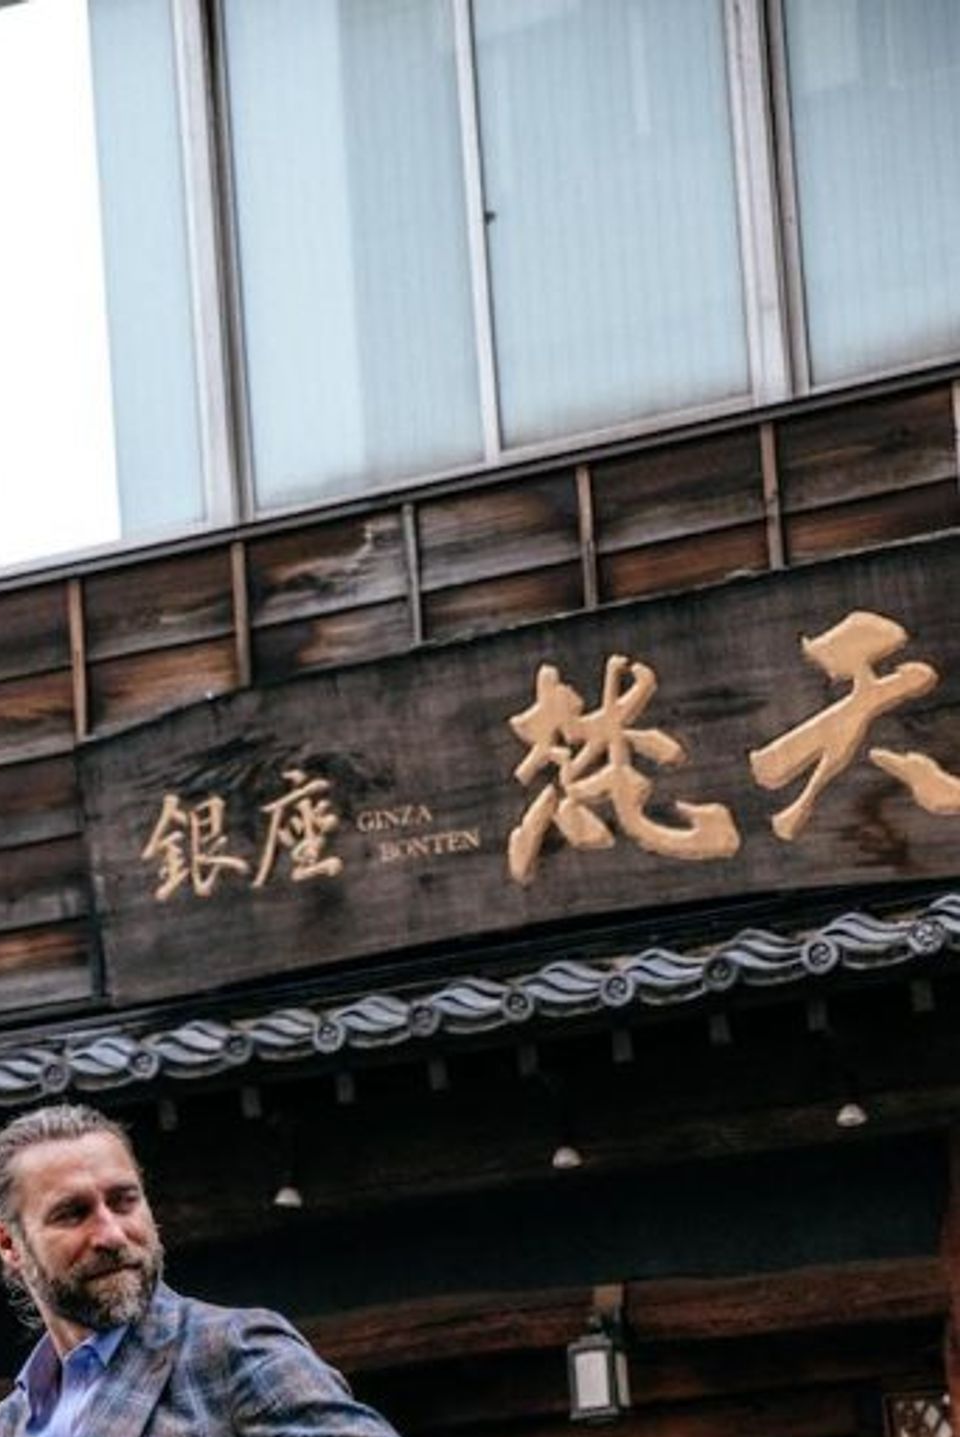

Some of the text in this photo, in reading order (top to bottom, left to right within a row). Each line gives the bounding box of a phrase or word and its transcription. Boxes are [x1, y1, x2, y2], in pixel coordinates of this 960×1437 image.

[141, 769, 344, 902] 銀座
[356, 803, 433, 832] GINZA
[380, 826, 481, 863] BONTEN
